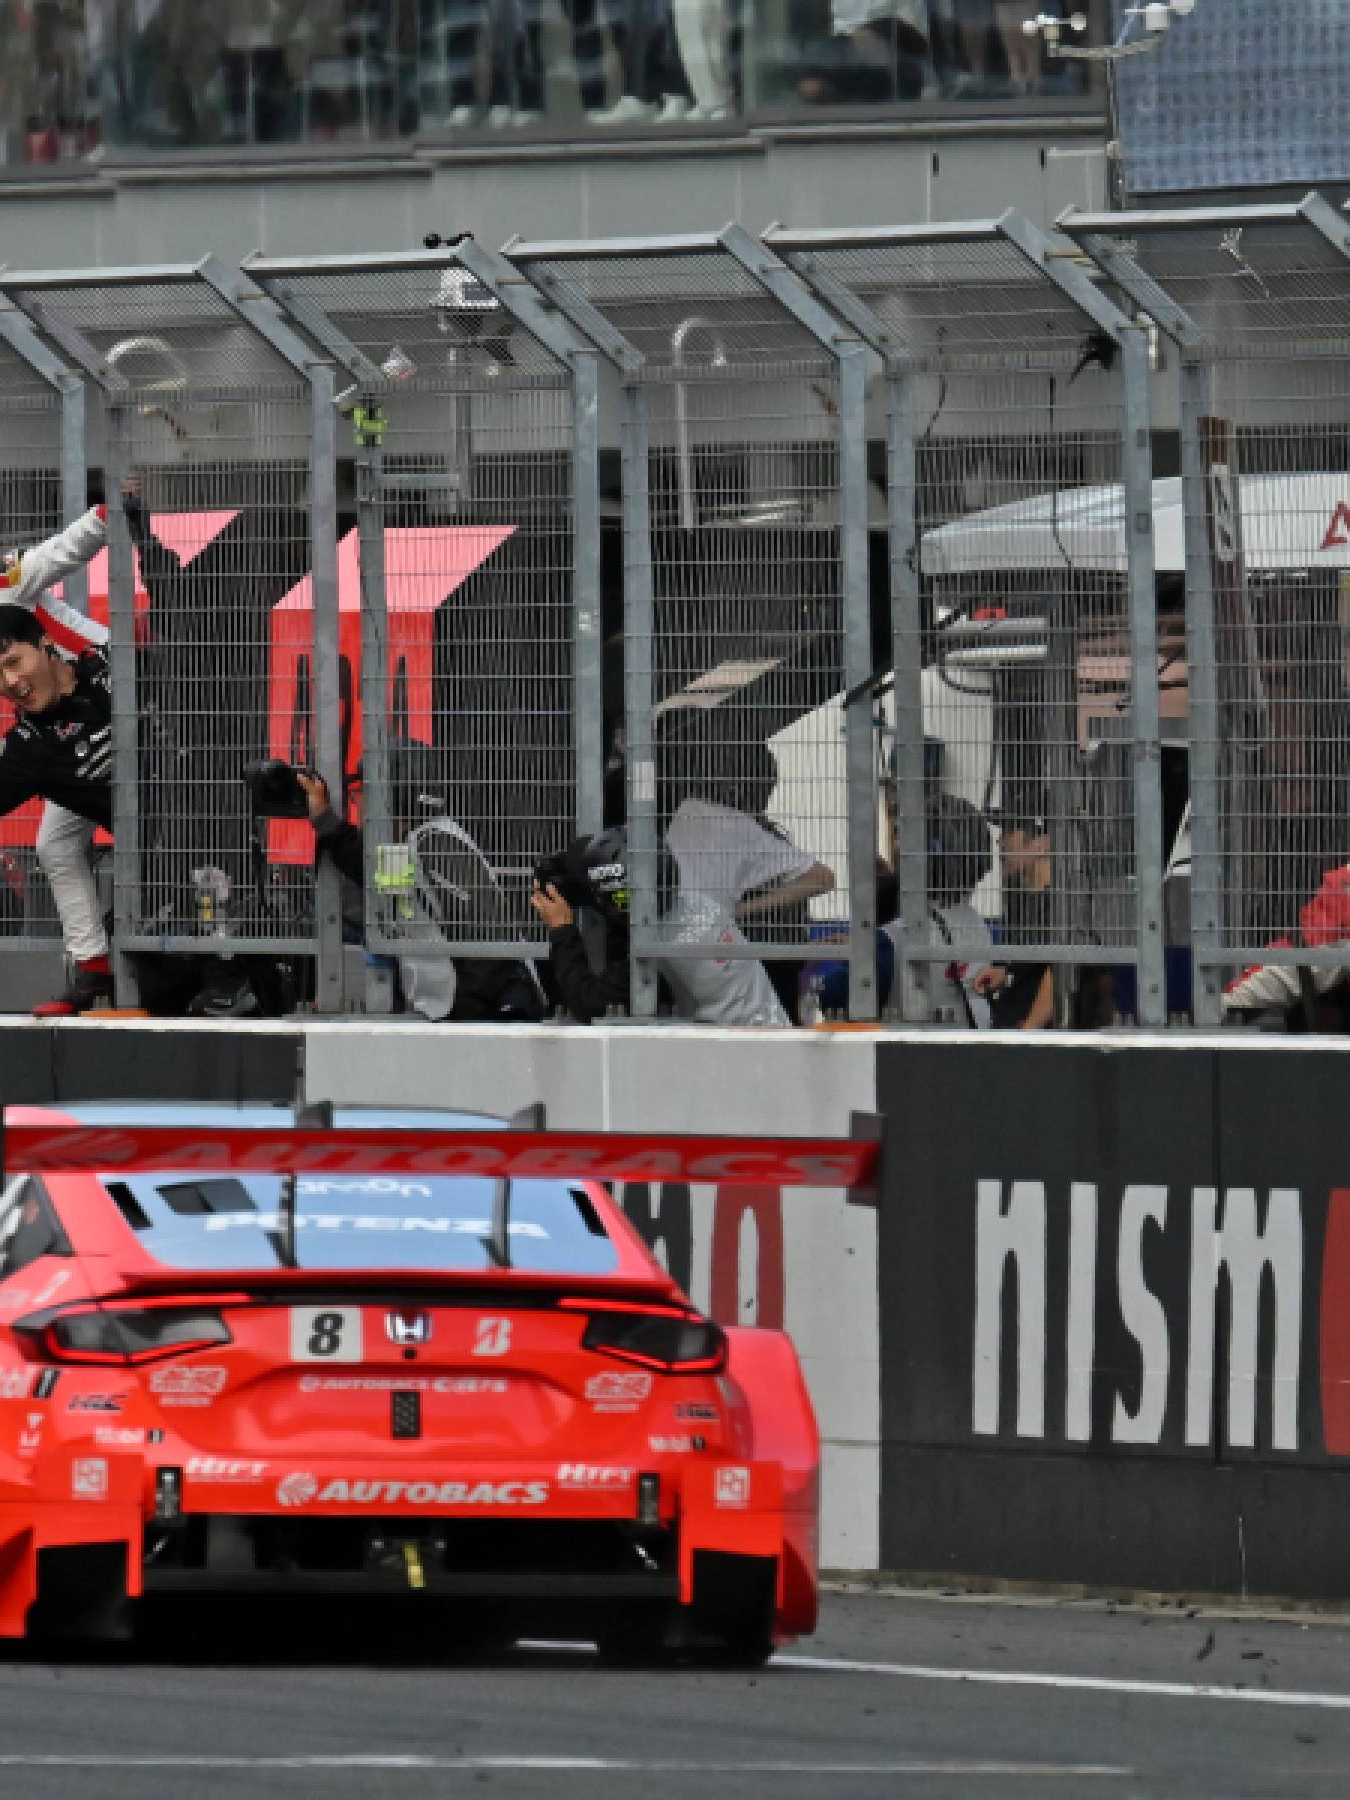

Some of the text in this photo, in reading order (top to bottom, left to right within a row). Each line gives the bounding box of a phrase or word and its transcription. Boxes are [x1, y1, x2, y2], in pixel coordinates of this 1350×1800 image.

[158, 1140, 856, 1185] AUTOBACS
[206, 1212, 549, 1239] POTENZA
[306, 1311, 345, 1356] 8
[319, 1478, 548, 1504] AUTOBACS
